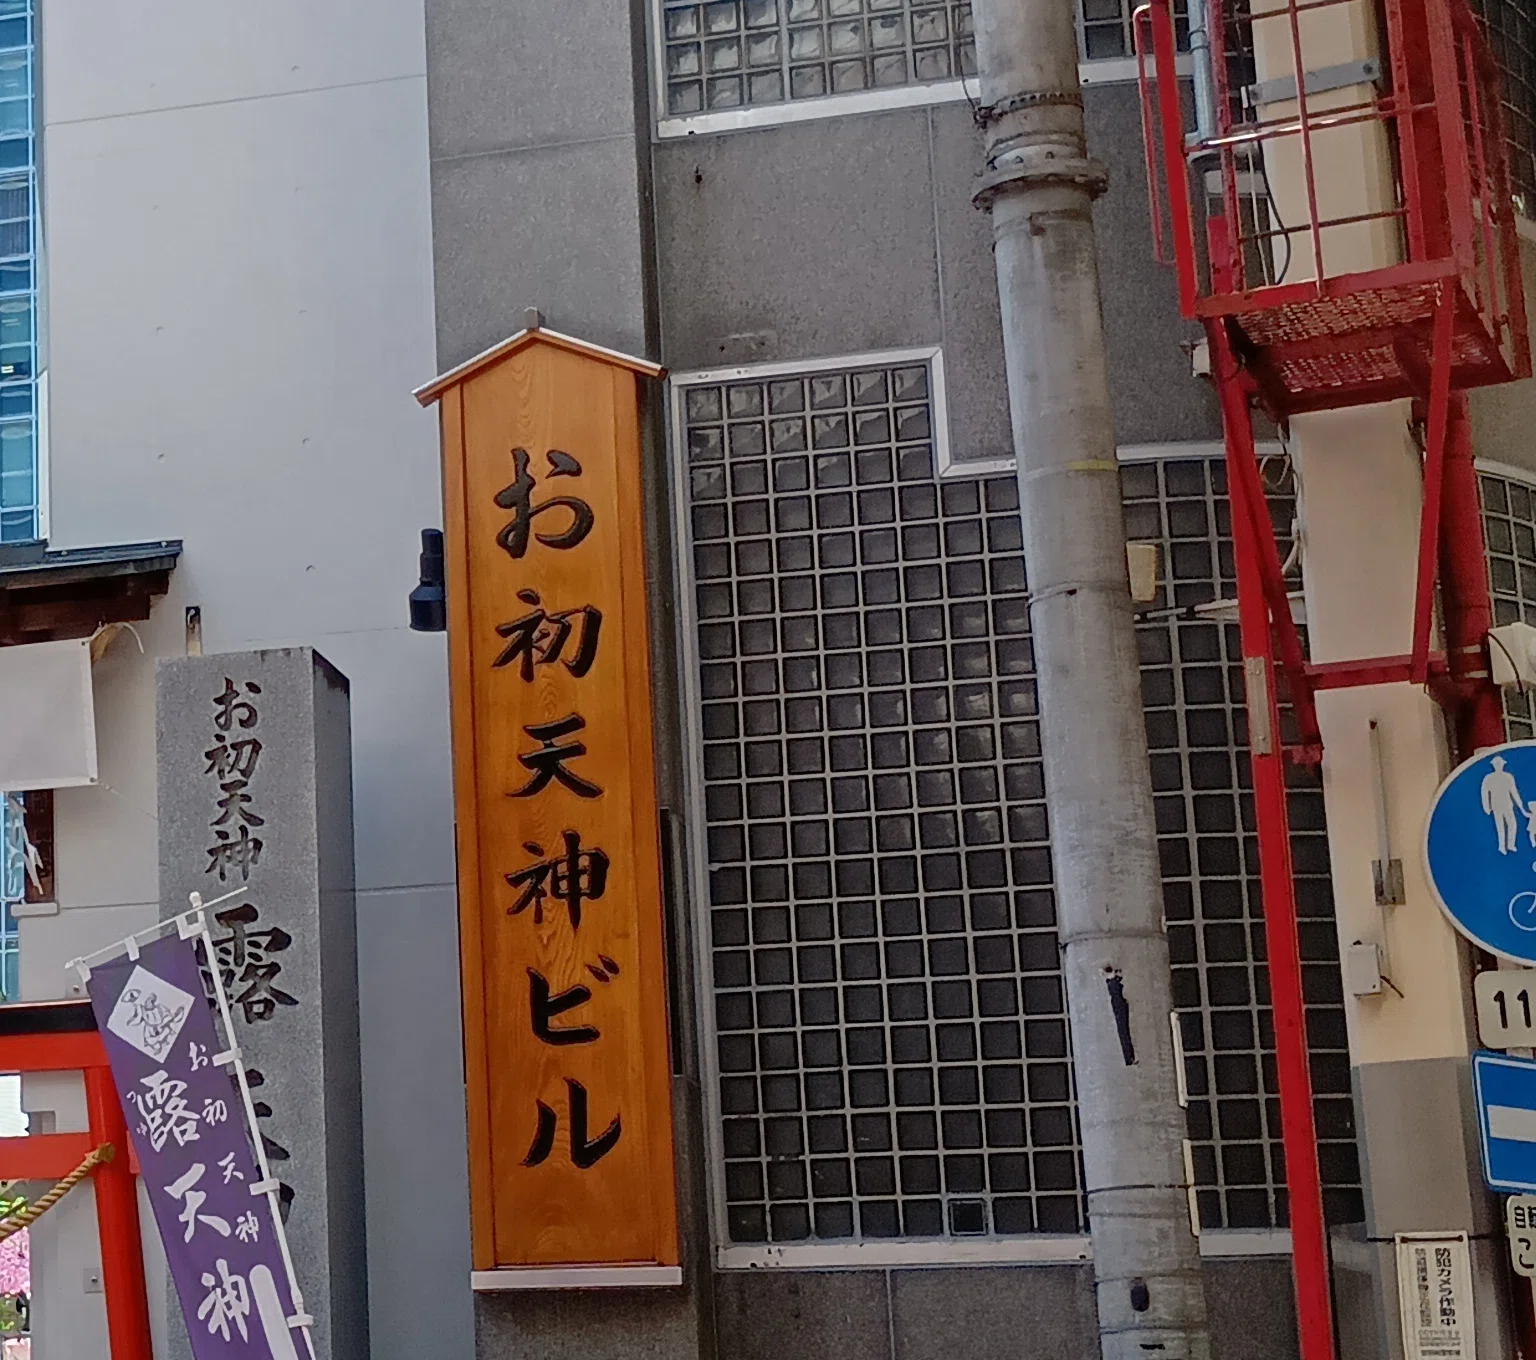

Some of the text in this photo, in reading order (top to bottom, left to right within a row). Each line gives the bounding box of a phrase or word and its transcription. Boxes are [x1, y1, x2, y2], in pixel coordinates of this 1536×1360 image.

[204, 676, 264, 882] お初天神
[493, 446, 622, 1172] お初天神ビル
[188, 1041, 260, 1244] お初天神
[1435, 1247, 1456, 1326] 防犯カメラ作動中
